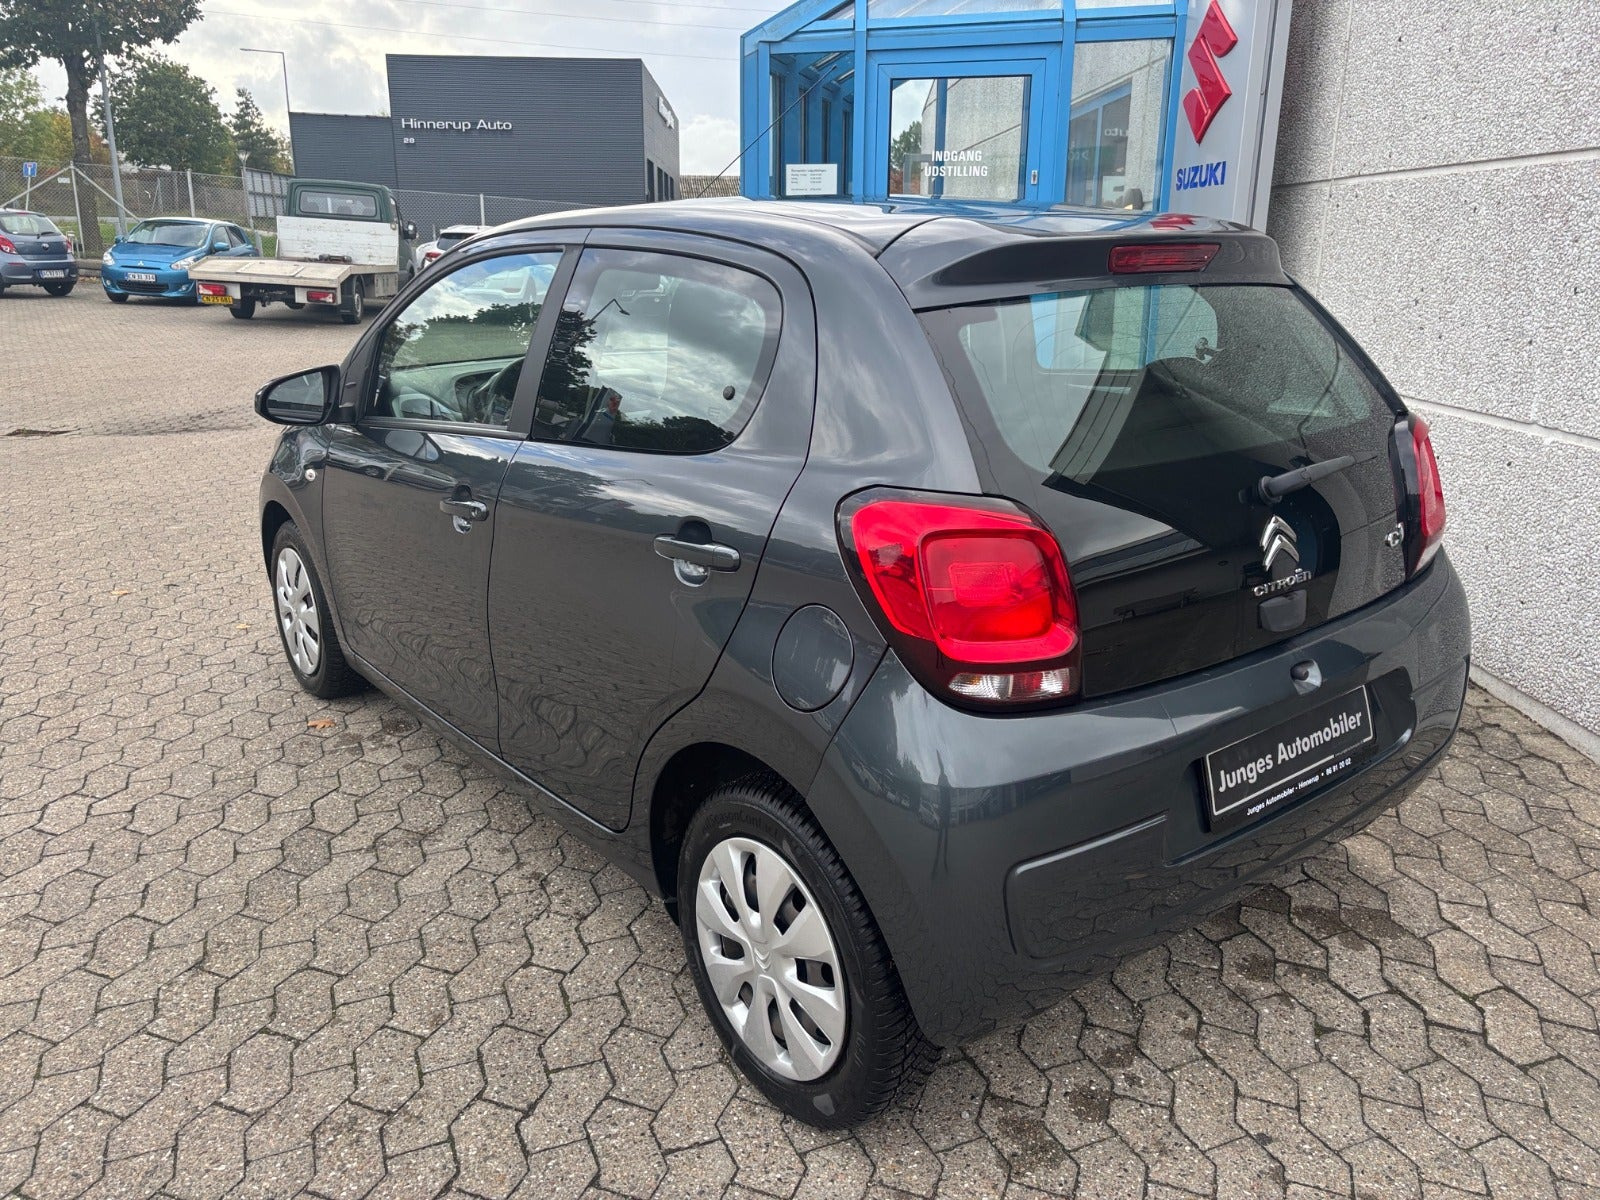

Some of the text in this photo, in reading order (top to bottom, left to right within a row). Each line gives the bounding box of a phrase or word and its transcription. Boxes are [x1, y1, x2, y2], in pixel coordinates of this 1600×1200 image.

[401, 118, 512, 132] Hinnerup Auto
[931, 150, 982, 162] INDGANG
[924, 165, 988, 177] UDSTILLING
[1176, 161, 1226, 191] SUZUKI
[1218, 711, 1362, 793] Junges Automobiler
[1246, 802, 1265, 816] Junges
[1265, 787, 1295, 806] Automobiler
[1298, 775, 1320, 790] Hinnerup
